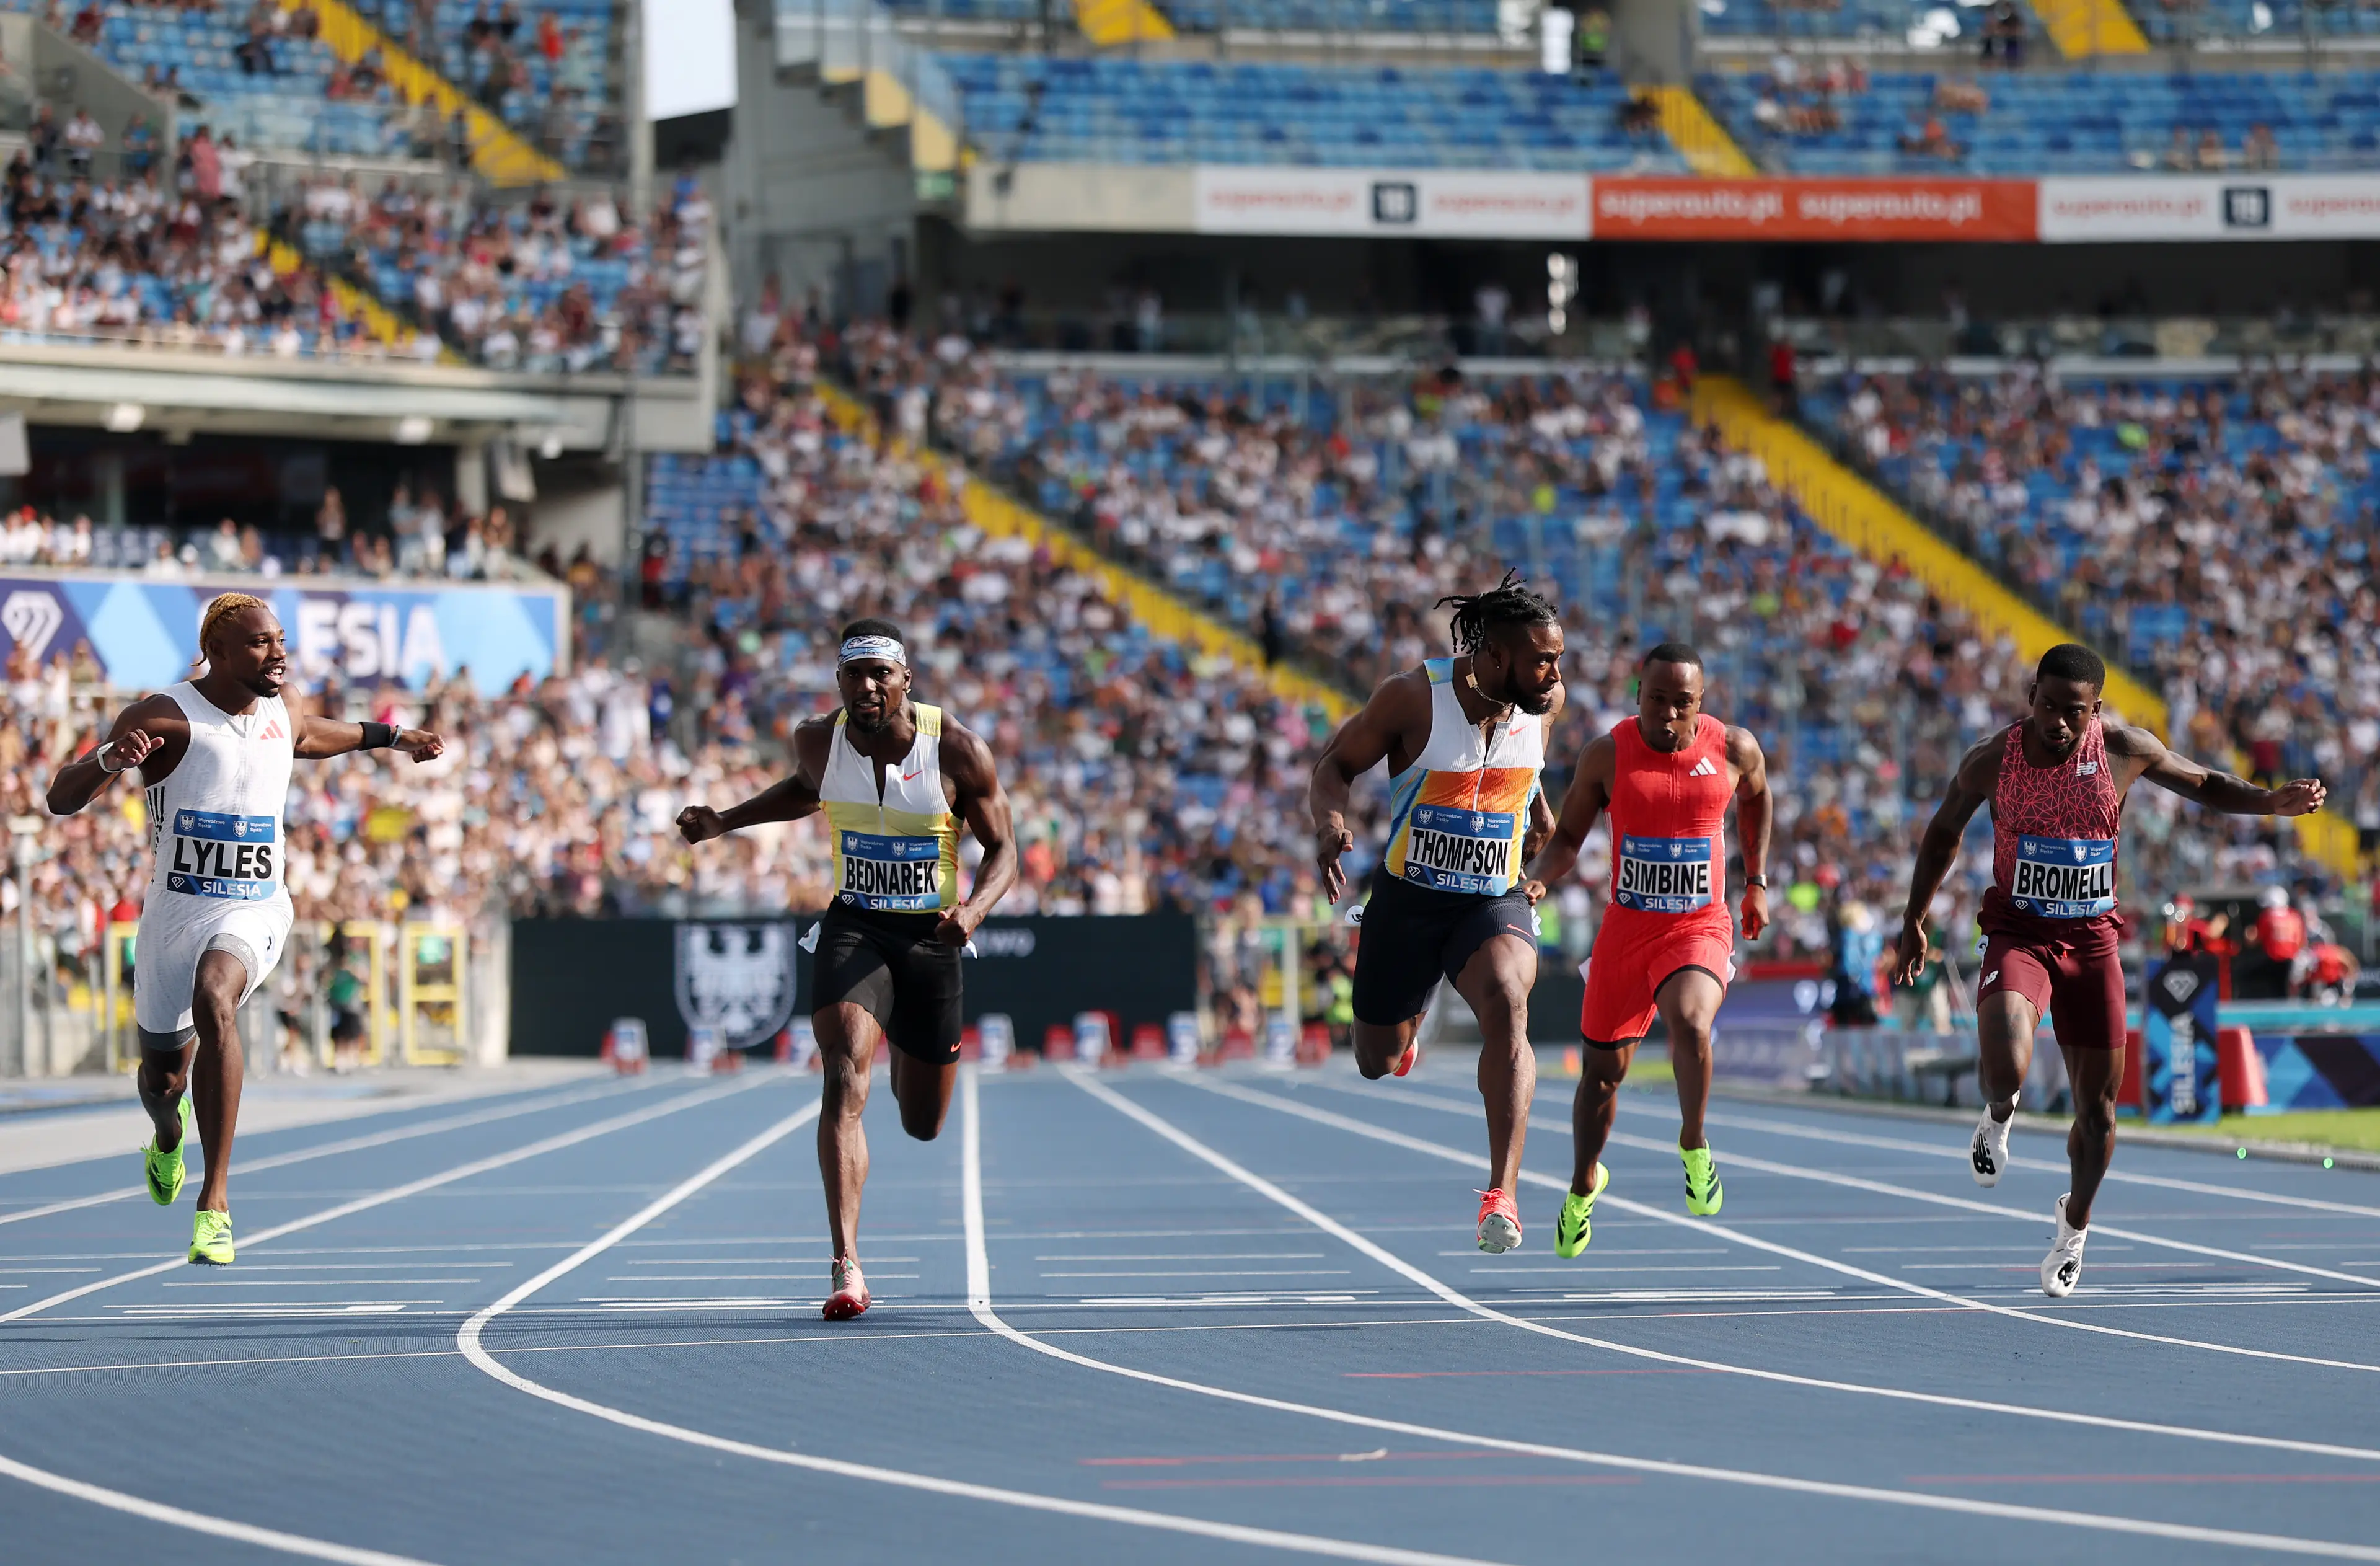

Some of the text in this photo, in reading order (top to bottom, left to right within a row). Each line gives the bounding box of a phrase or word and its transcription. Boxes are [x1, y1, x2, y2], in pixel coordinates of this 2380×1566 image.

[173, 837, 272, 879] LYLES
[1412, 829, 1509, 875] THOMPSON
[203, 881, 262, 896] SILESIA
[845, 856, 937, 896] BEDNAREK
[1436, 873, 1494, 893] SILESIA
[1622, 859, 1708, 895] SIMBINE
[2017, 862, 2110, 900] BROMELL
[870, 898, 927, 910] SILESIA
[1645, 898, 1698, 911] SILESIA
[2045, 902, 2100, 916] SILESIA
[2171, 1011, 2196, 1114] SILESIA
